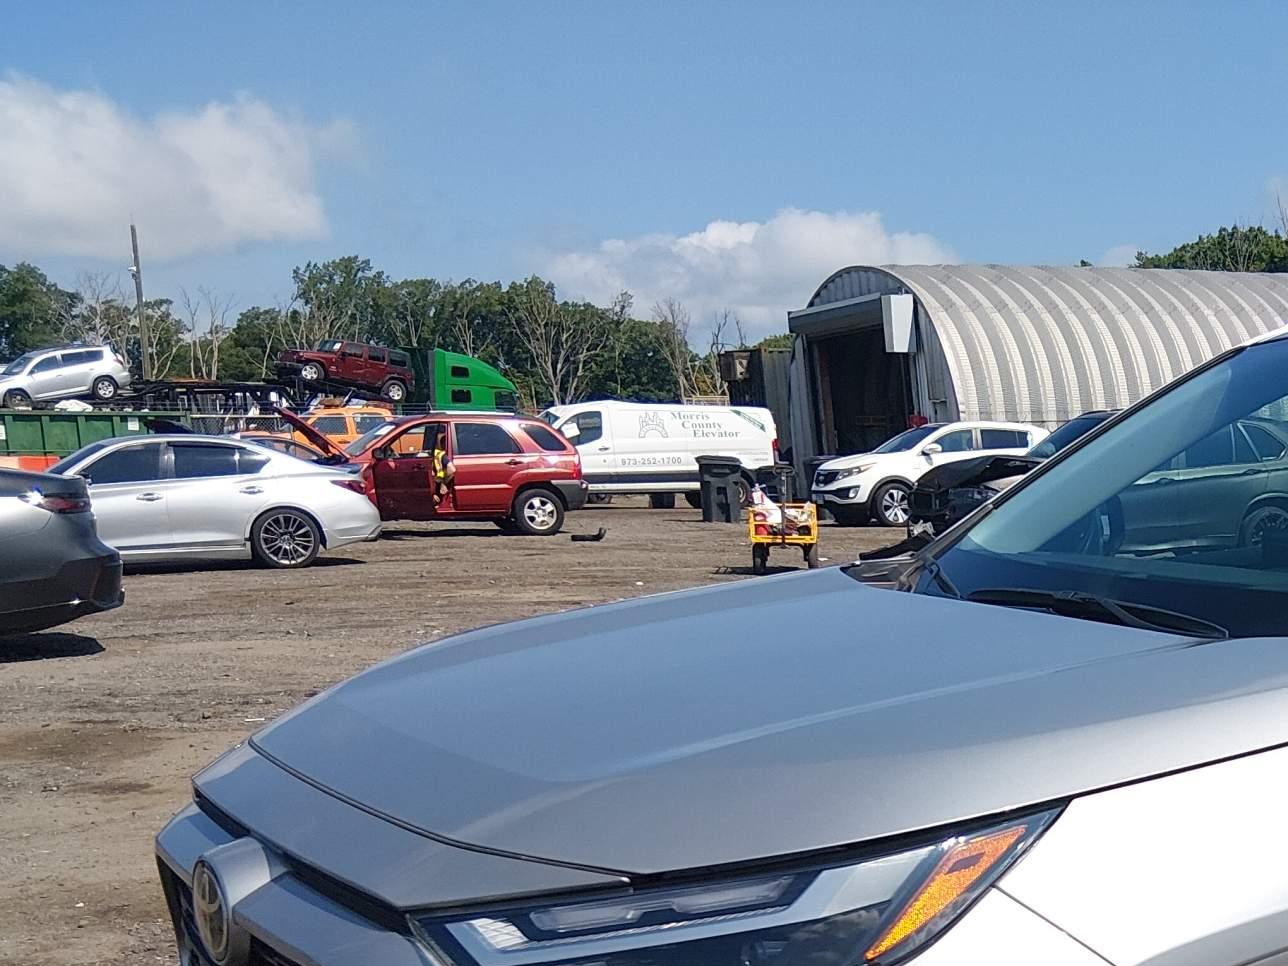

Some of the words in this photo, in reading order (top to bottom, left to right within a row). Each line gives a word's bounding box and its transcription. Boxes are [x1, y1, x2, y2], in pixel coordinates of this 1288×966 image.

[670, 410, 710, 421] Morris
[681, 420, 722, 431] County
[692, 429, 741, 439] Elevator
